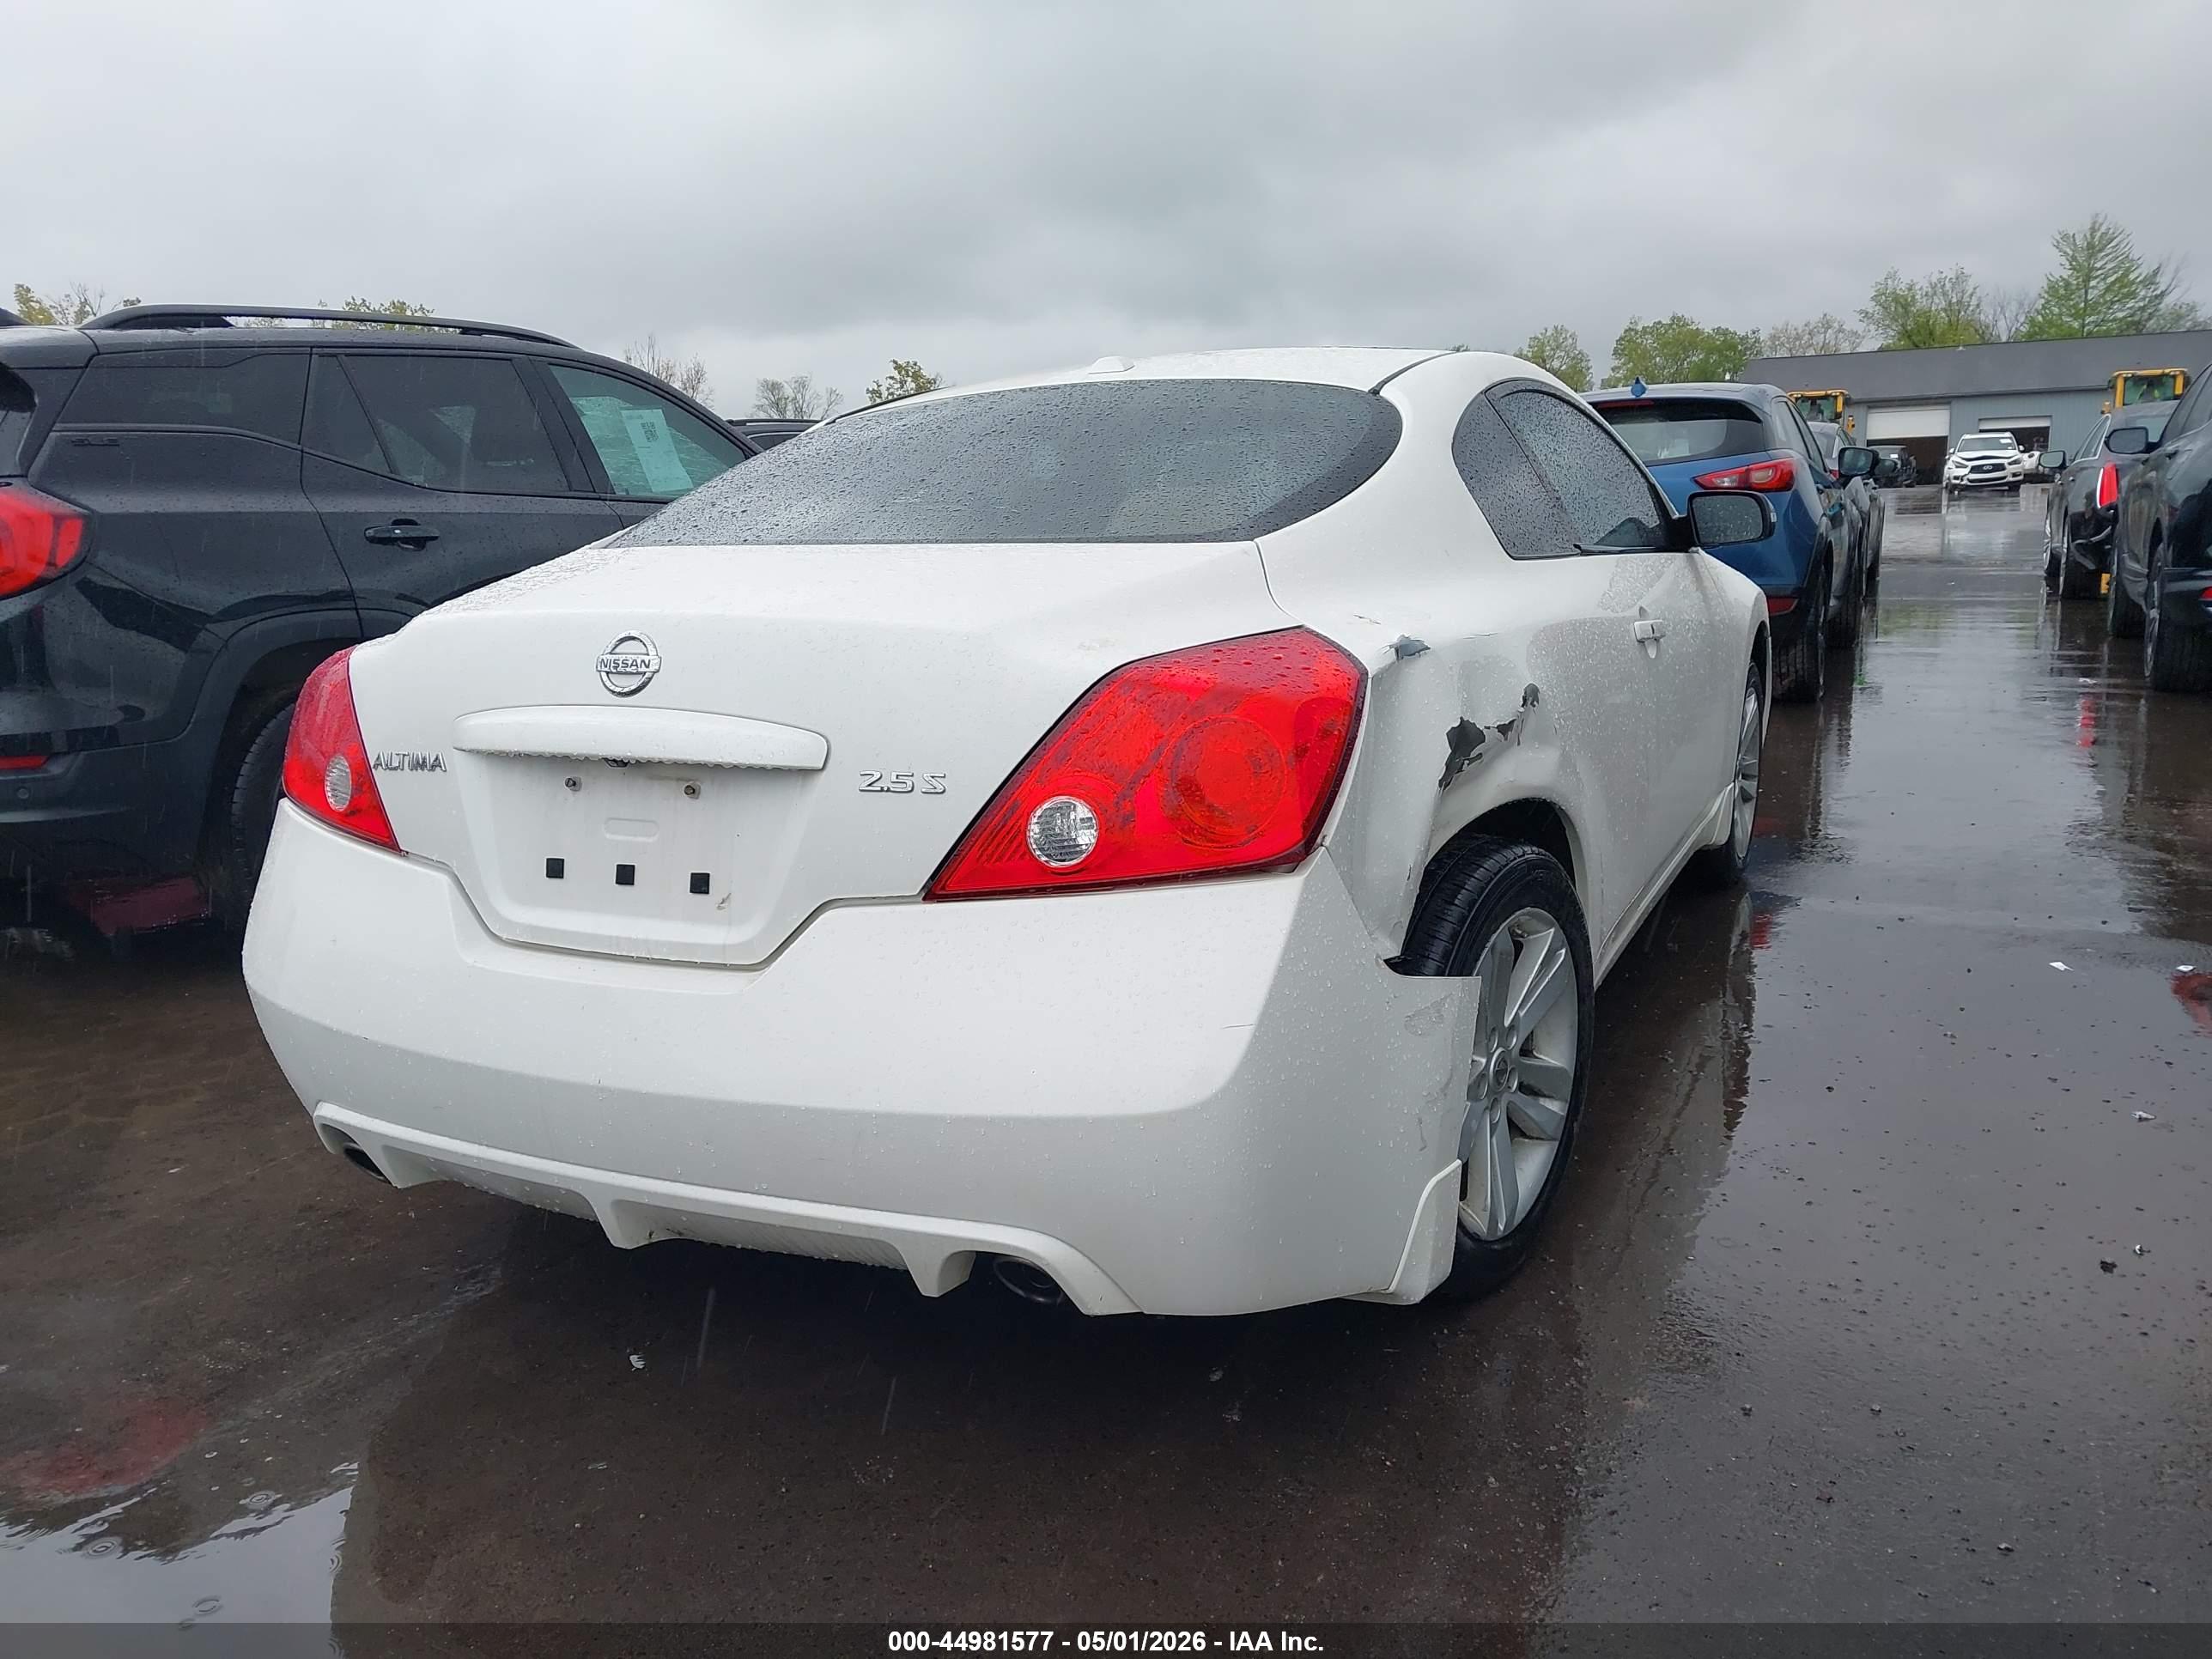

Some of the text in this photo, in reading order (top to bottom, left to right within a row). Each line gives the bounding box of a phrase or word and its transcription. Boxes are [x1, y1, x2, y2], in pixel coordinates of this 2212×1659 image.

[599, 658, 651, 670] NISSAN
[372, 751, 447, 773] ALTIMA
[859, 769, 946, 795] 2.5 S
